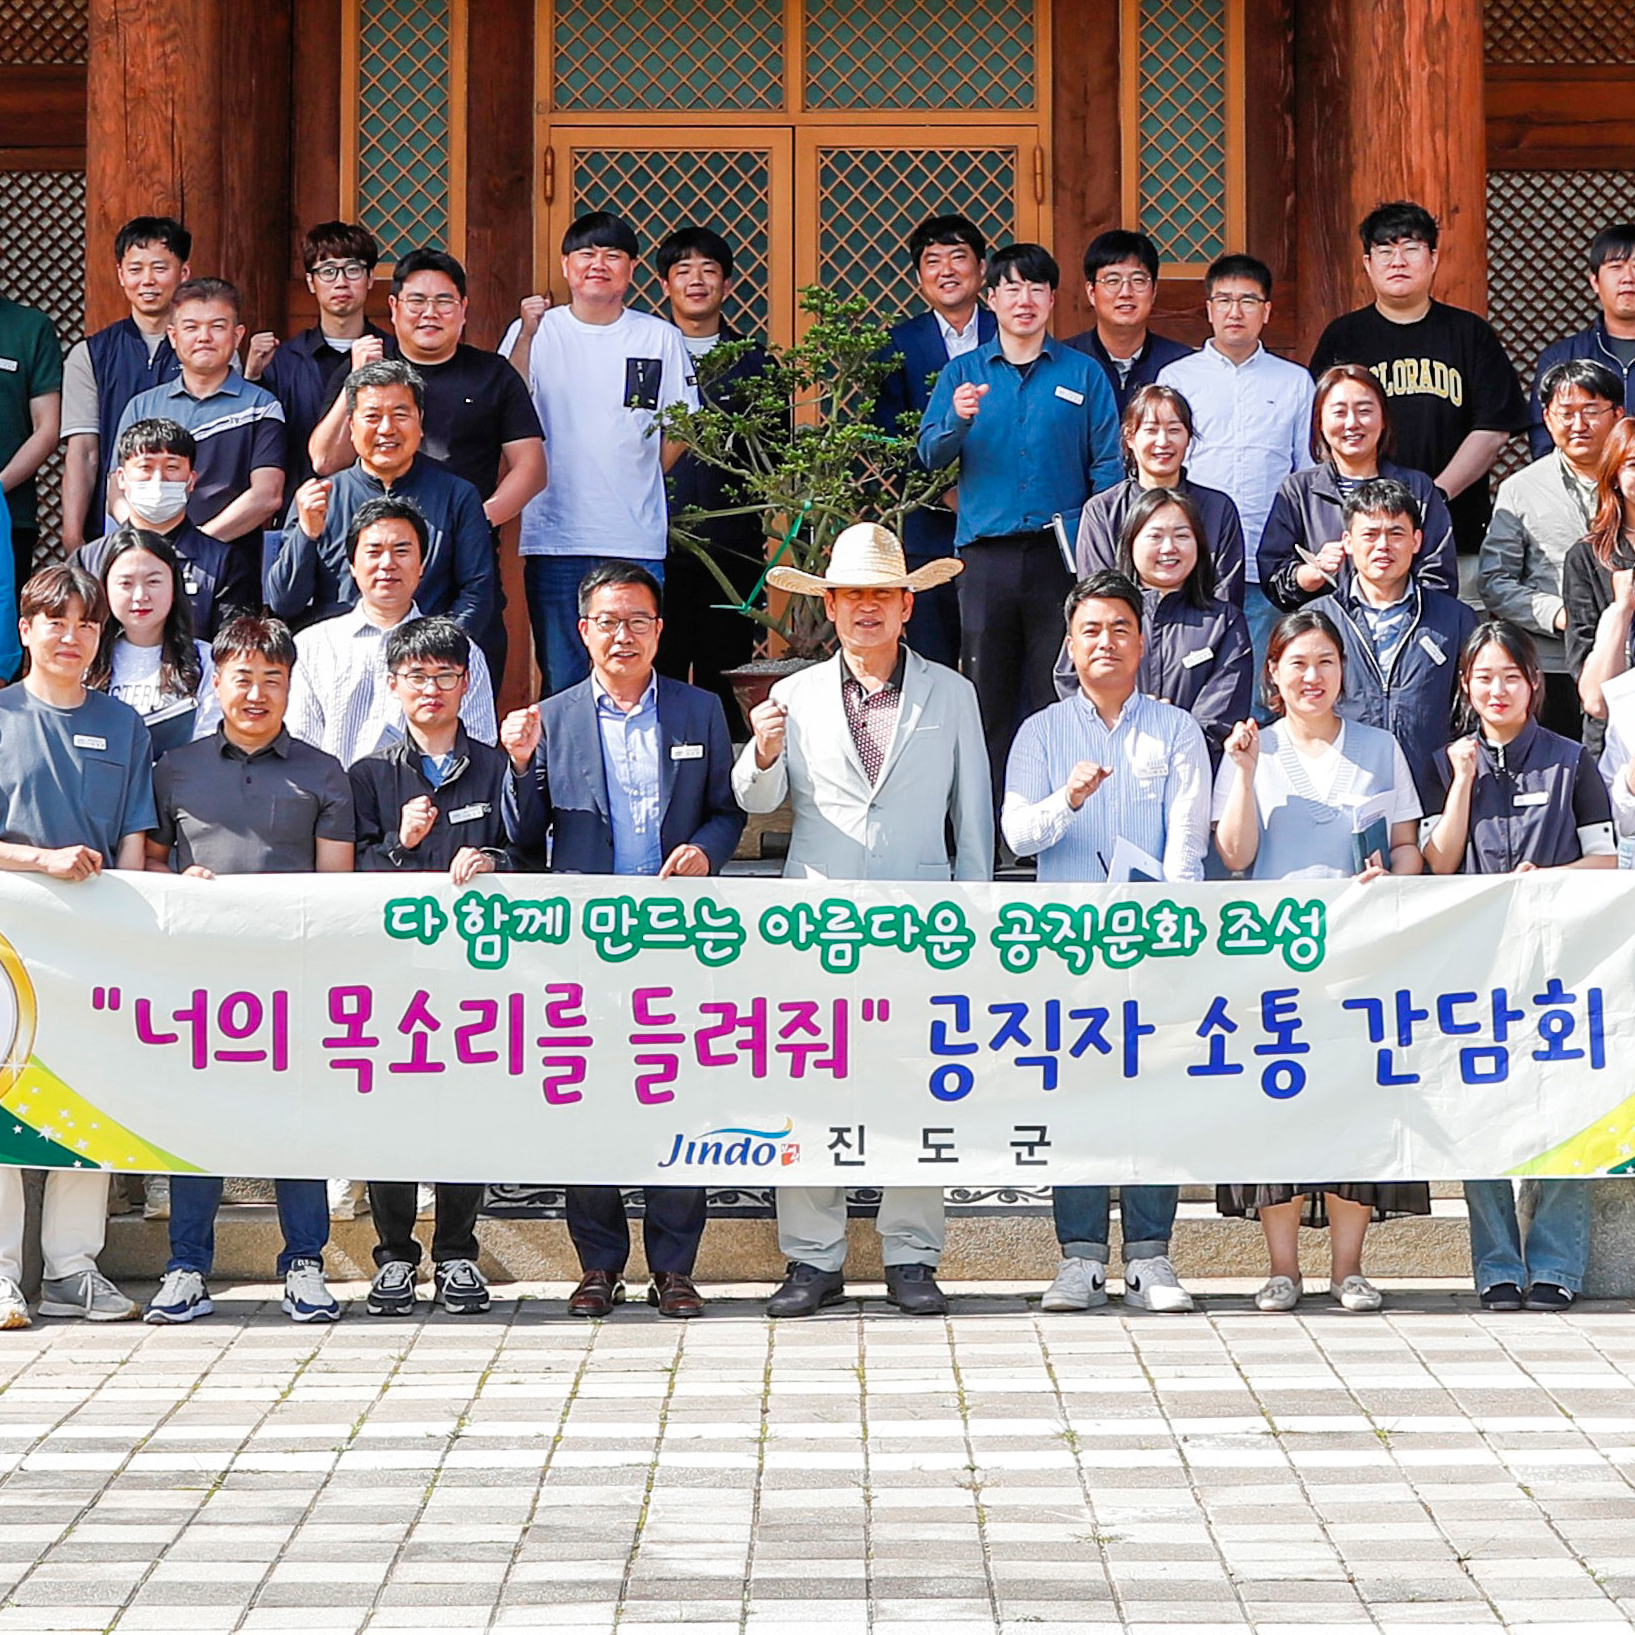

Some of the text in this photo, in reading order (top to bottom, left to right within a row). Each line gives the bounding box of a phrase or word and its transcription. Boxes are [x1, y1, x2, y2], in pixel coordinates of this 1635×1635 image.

[1368, 358, 1463, 408] LORADO
[583, 896, 748, 968] 만드는
[760, 899, 976, 975] 아름다운
[991, 900, 1209, 976] 공직문화
[1217, 899, 1328, 973] 조성
[92, 978, 1607, 1107] "너의 목소리를 들려줘" 공직자 소통 간담회
